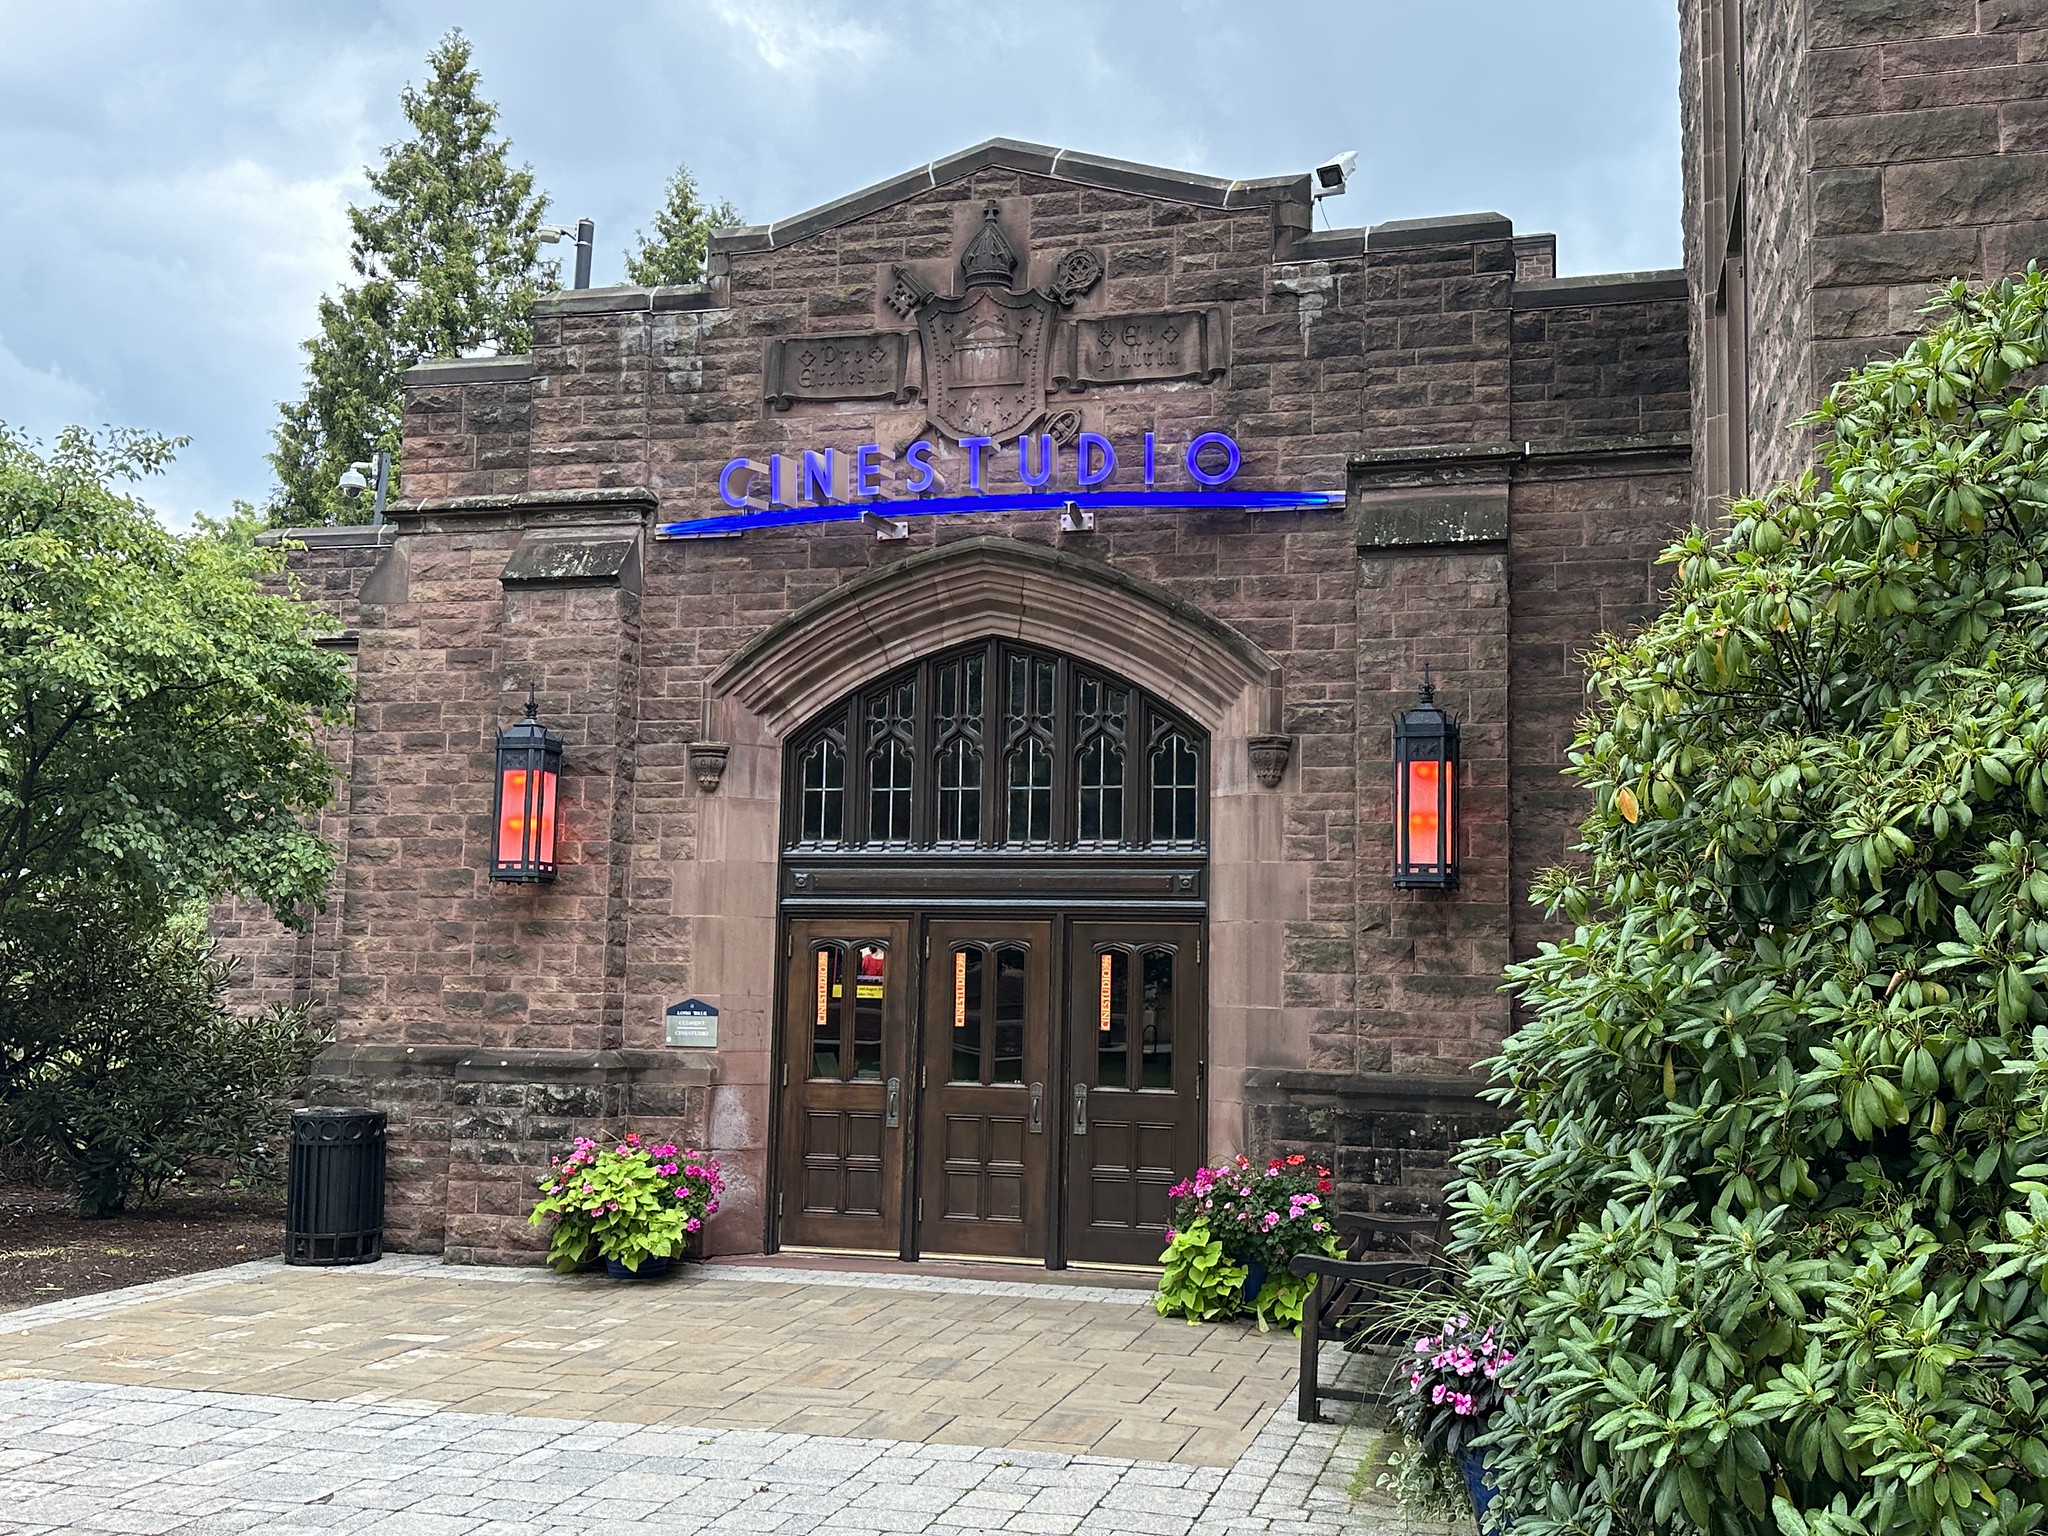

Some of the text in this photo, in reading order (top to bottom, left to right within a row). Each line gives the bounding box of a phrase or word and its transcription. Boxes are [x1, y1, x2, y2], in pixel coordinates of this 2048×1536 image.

[717, 431, 1243, 508] CINESTUDIO
[817, 964, 828, 1024] CINESTUDIO
[955, 966, 965, 1026] CINESTUDIO
[1101, 970, 1111, 1030] CINESTUDIO
